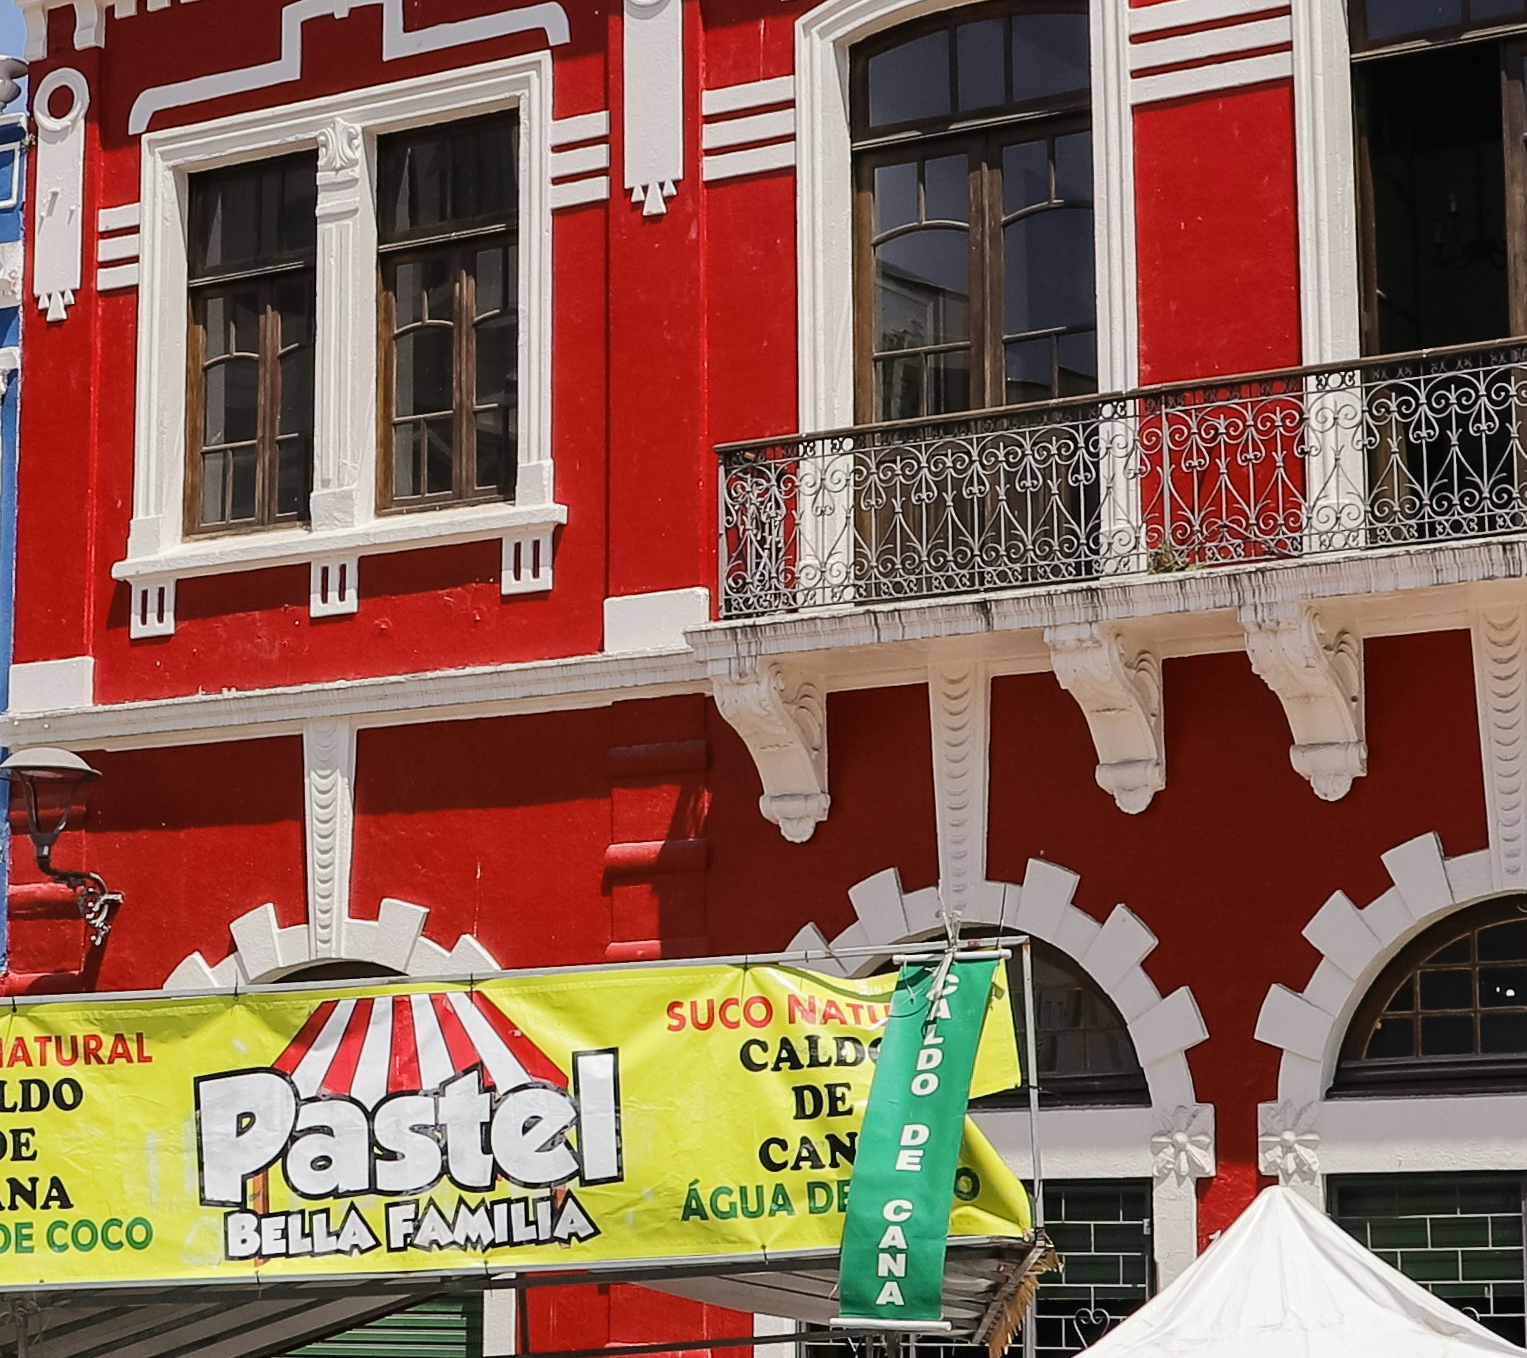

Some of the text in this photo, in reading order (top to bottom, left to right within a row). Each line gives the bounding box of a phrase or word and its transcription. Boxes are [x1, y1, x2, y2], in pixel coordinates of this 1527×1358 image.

[666, 994, 773, 1032] SUCO
[910, 973, 960, 1097] CALDO
[792, 1083, 854, 1120] DE
[193, 1047, 624, 1207] Pastel
[895, 1123, 930, 1172] DE
[759, 1132, 857, 1172] CAN
[681, 1179, 796, 1222] ÁGUA
[47, 1217, 153, 1252] COCO
[224, 1201, 381, 1261] BELLA
[875, 1198, 914, 1307] CANA
